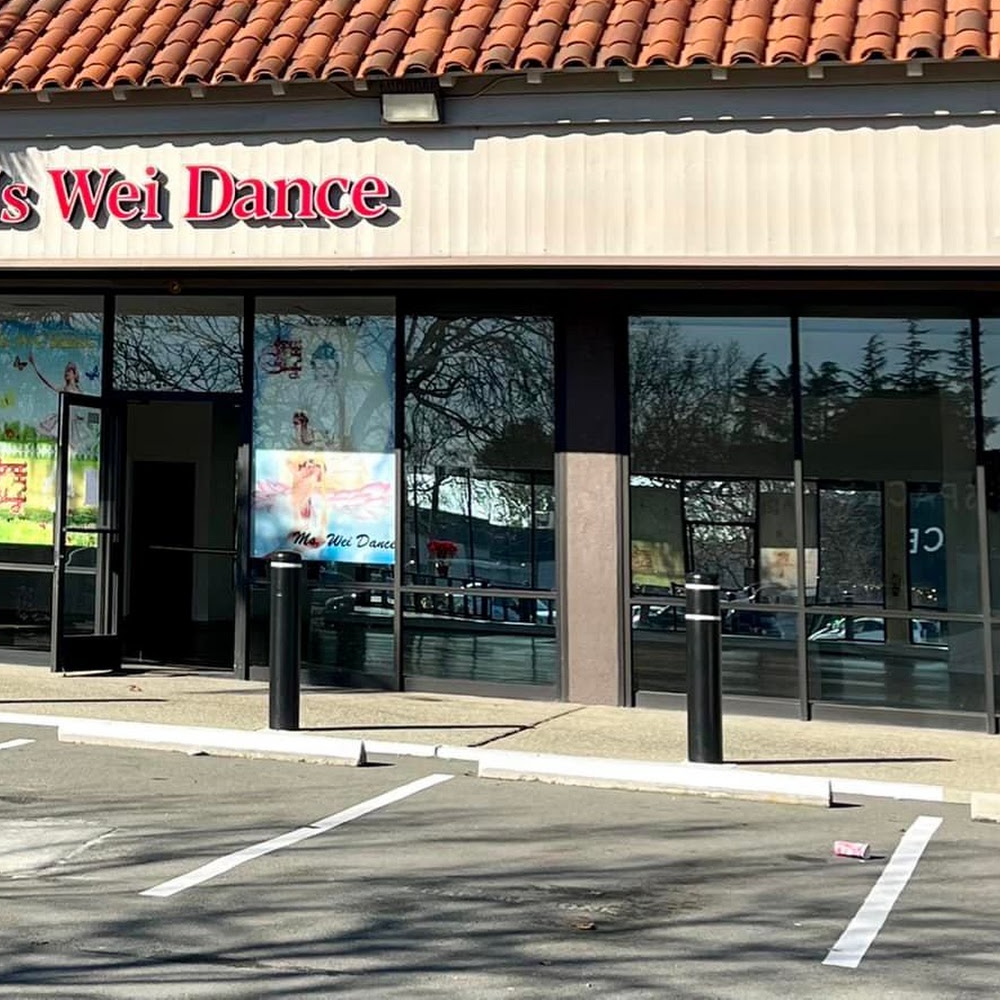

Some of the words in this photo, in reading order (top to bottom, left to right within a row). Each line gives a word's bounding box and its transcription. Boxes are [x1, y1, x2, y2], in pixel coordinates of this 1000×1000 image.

[49, 166, 162, 219] Wei
[184, 165, 390, 219] Dance
[326, 533, 353, 547] Wei
